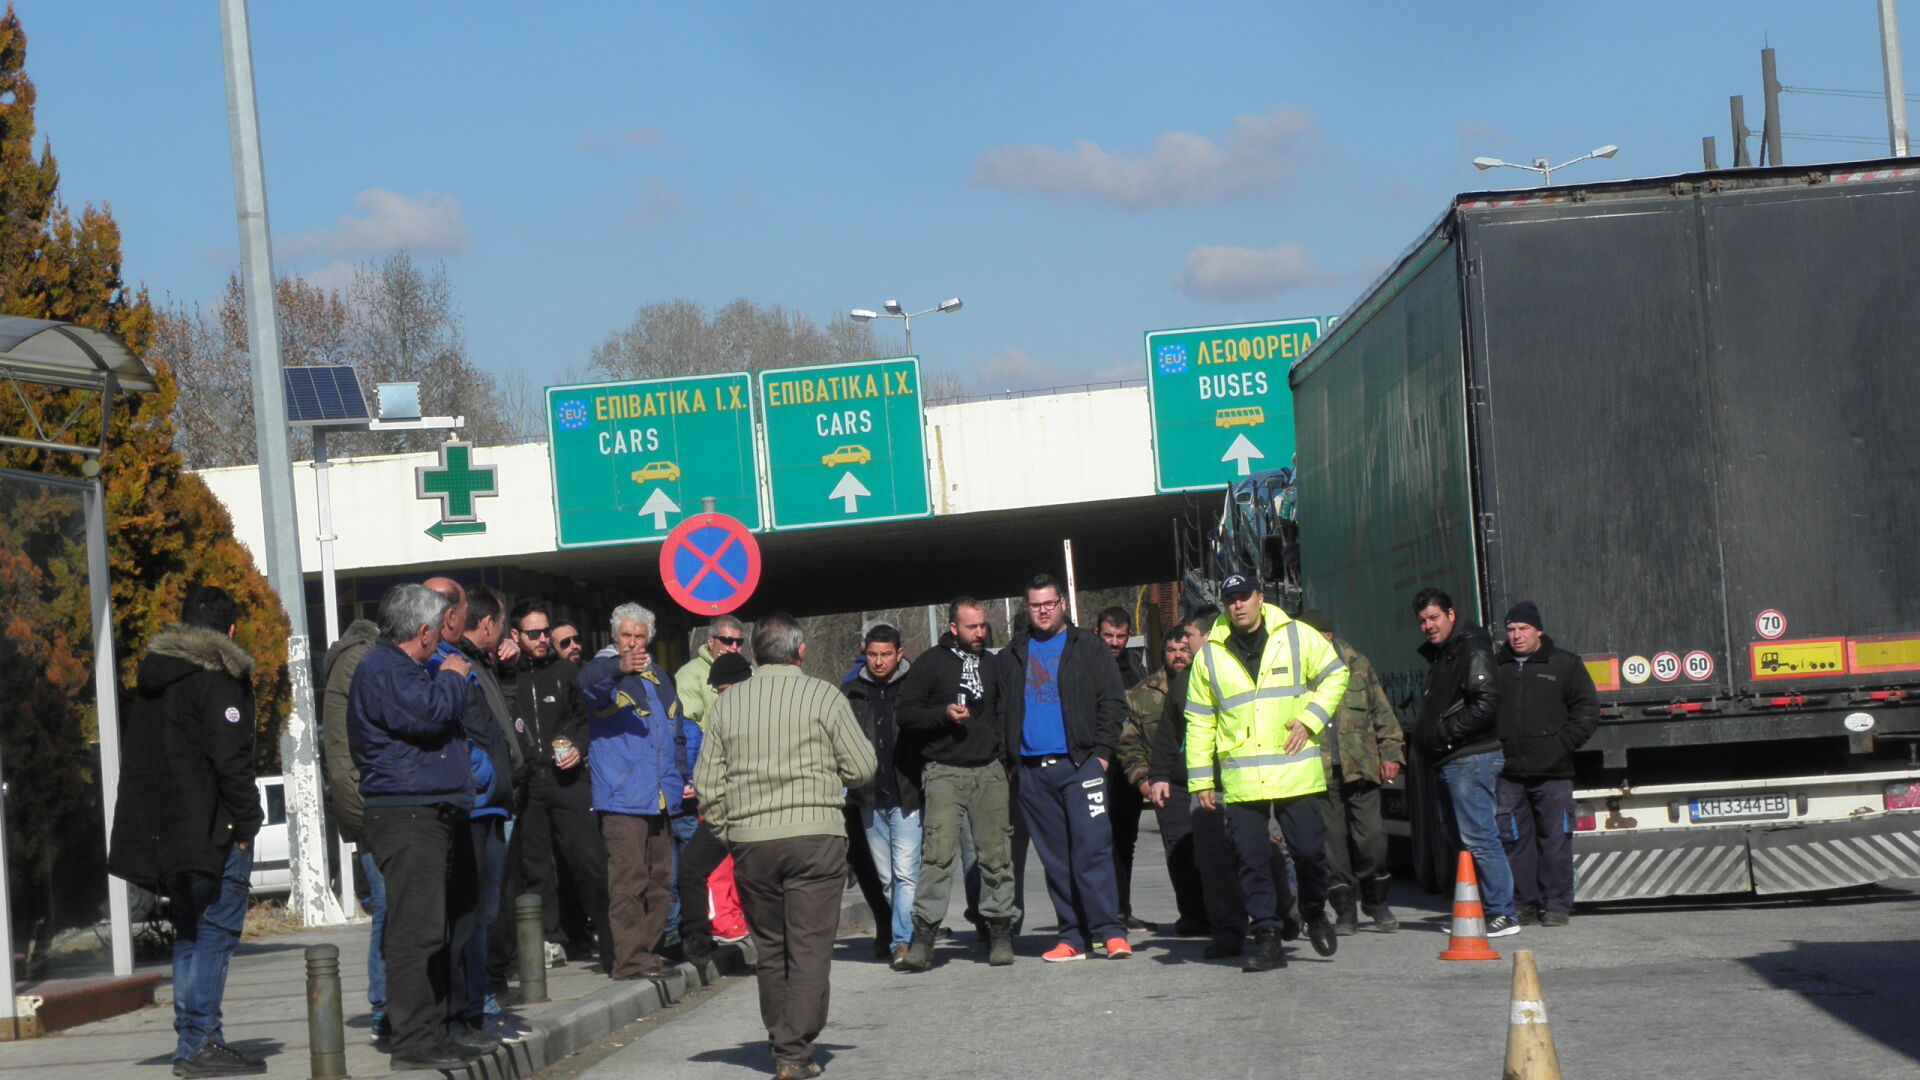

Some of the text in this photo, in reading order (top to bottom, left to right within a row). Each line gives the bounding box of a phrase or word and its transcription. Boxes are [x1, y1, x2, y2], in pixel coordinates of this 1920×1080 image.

[1165, 353, 1182, 365] EU
[1197, 332, 1313, 365] ΛΕΩΦΟΡΕΙΑ
[768, 373, 879, 407] ΕΠΙΒΑΤΙΚΑ
[1199, 371, 1269, 400] BUSES
[565, 407, 582, 420] EU
[595, 388, 707, 421] ΕΠΙΒΑΤΙΚΑ
[816, 409, 872, 437] CARS
[599, 428, 659, 456] CARS
[1761, 615, 1781, 630] 70
[1628, 662, 1645, 675] 90
[1657, 658, 1676, 673] 50
[1689, 657, 1708, 672] 60
